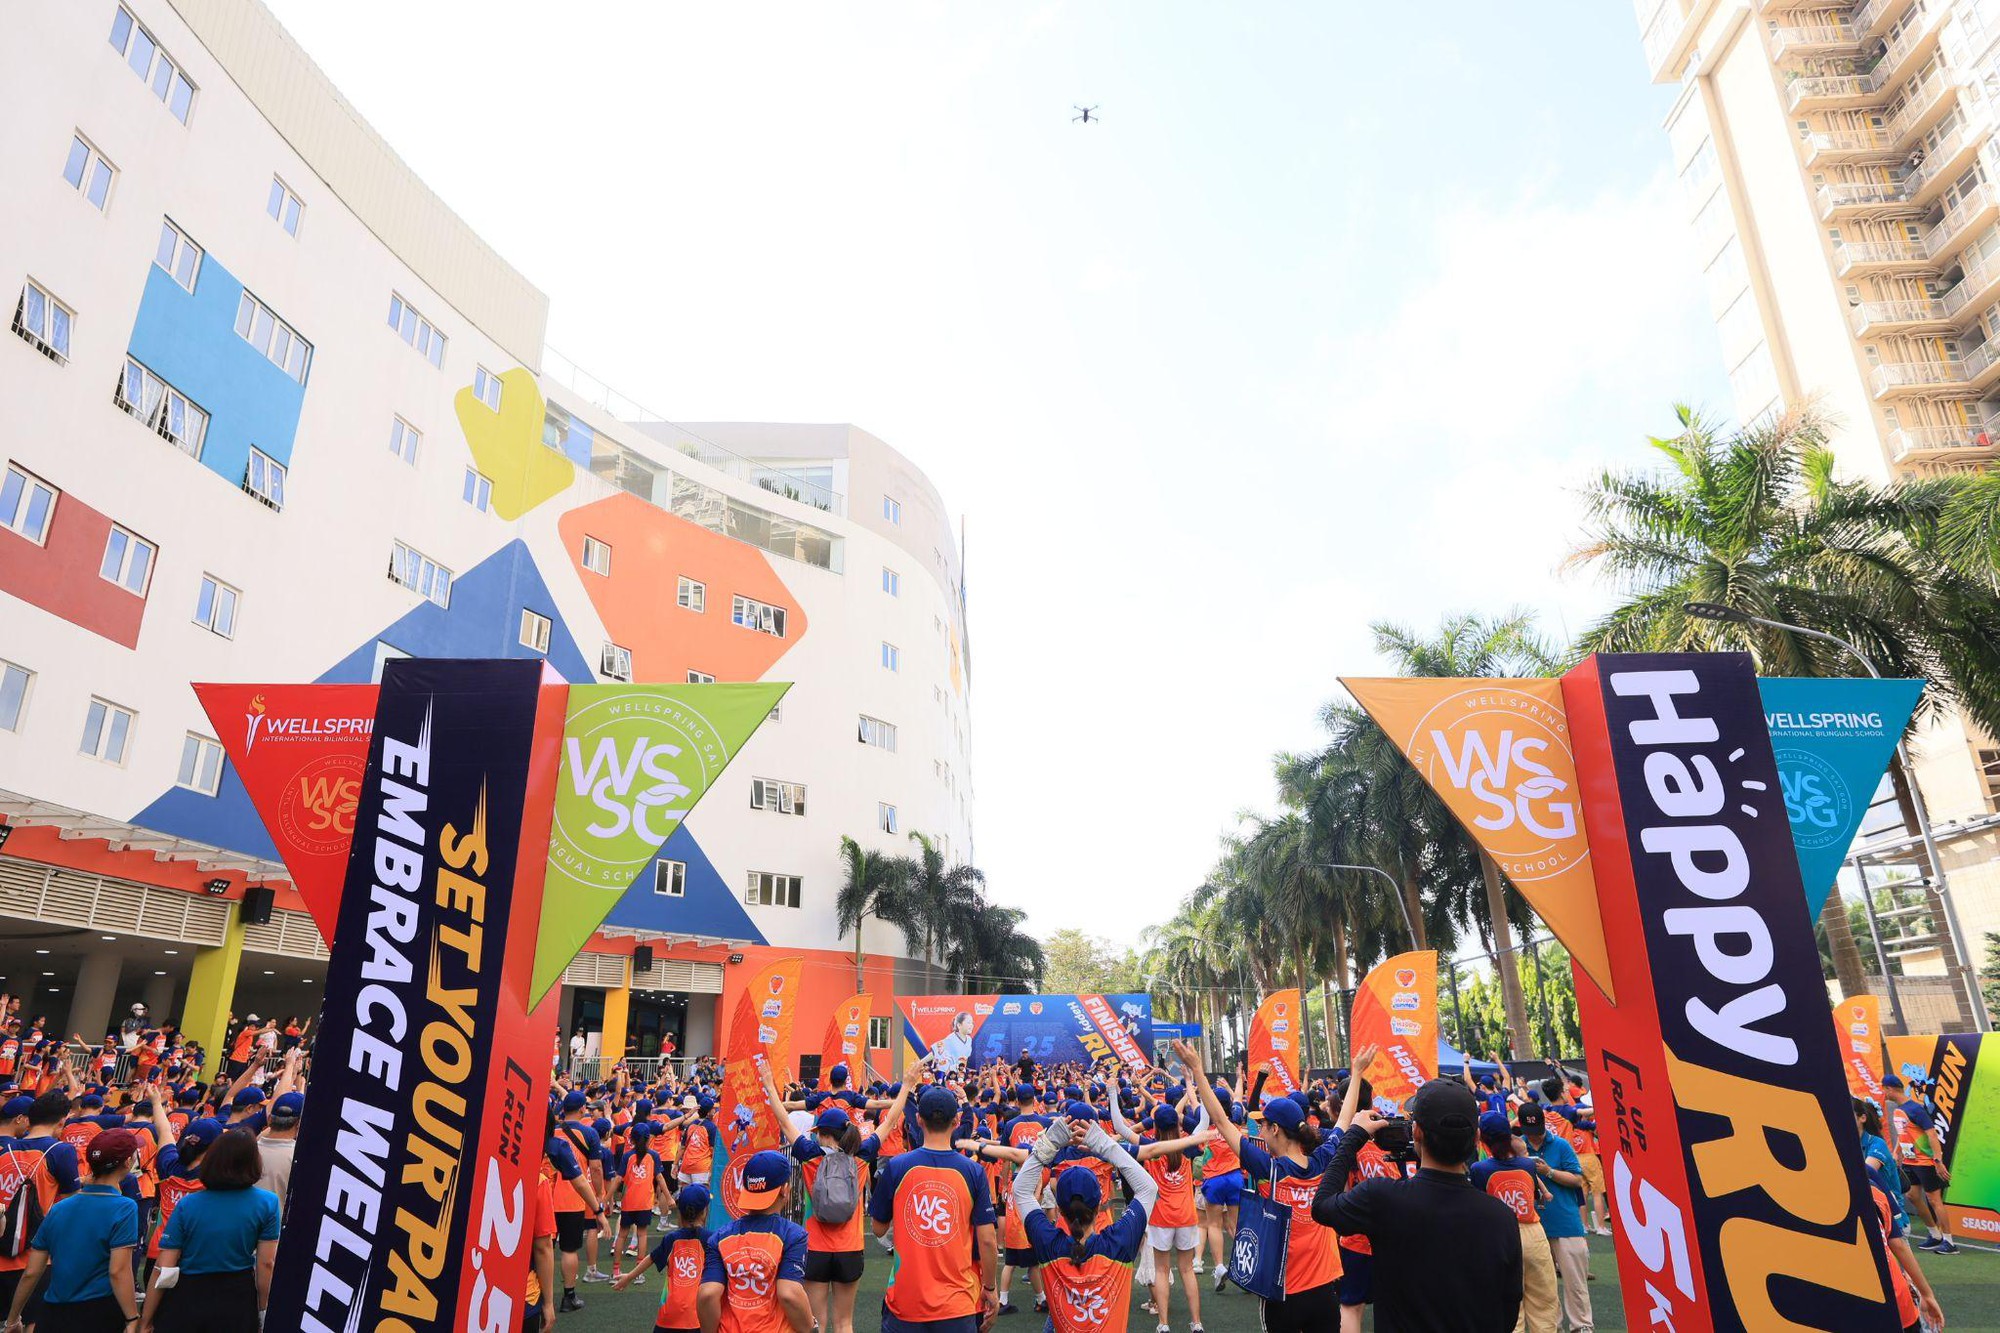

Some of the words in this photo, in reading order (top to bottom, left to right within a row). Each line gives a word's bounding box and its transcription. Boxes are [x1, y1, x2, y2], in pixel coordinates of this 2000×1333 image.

[609, 702, 705, 739] WELLSPRING
[1465, 696, 1566, 732] WELLSPRING
[349, 691, 434, 1091] EMBRACE
[435, 771, 489, 974] SET
[1502, 852, 1567, 875] SCHOOL
[1610, 670, 1799, 1066] Happy
[1067, 1001, 1094, 1032] Happy
[402, 917, 478, 1203] YOUR
[1388, 1045, 1426, 1090] Happ
[1934, 1040, 1967, 1125] RUN
[498, 1088, 515, 1160] RUN
[510, 1104, 526, 1168] FUN
[1610, 1077, 1633, 1158] RACE
[1630, 1106, 1647, 1152] UP
